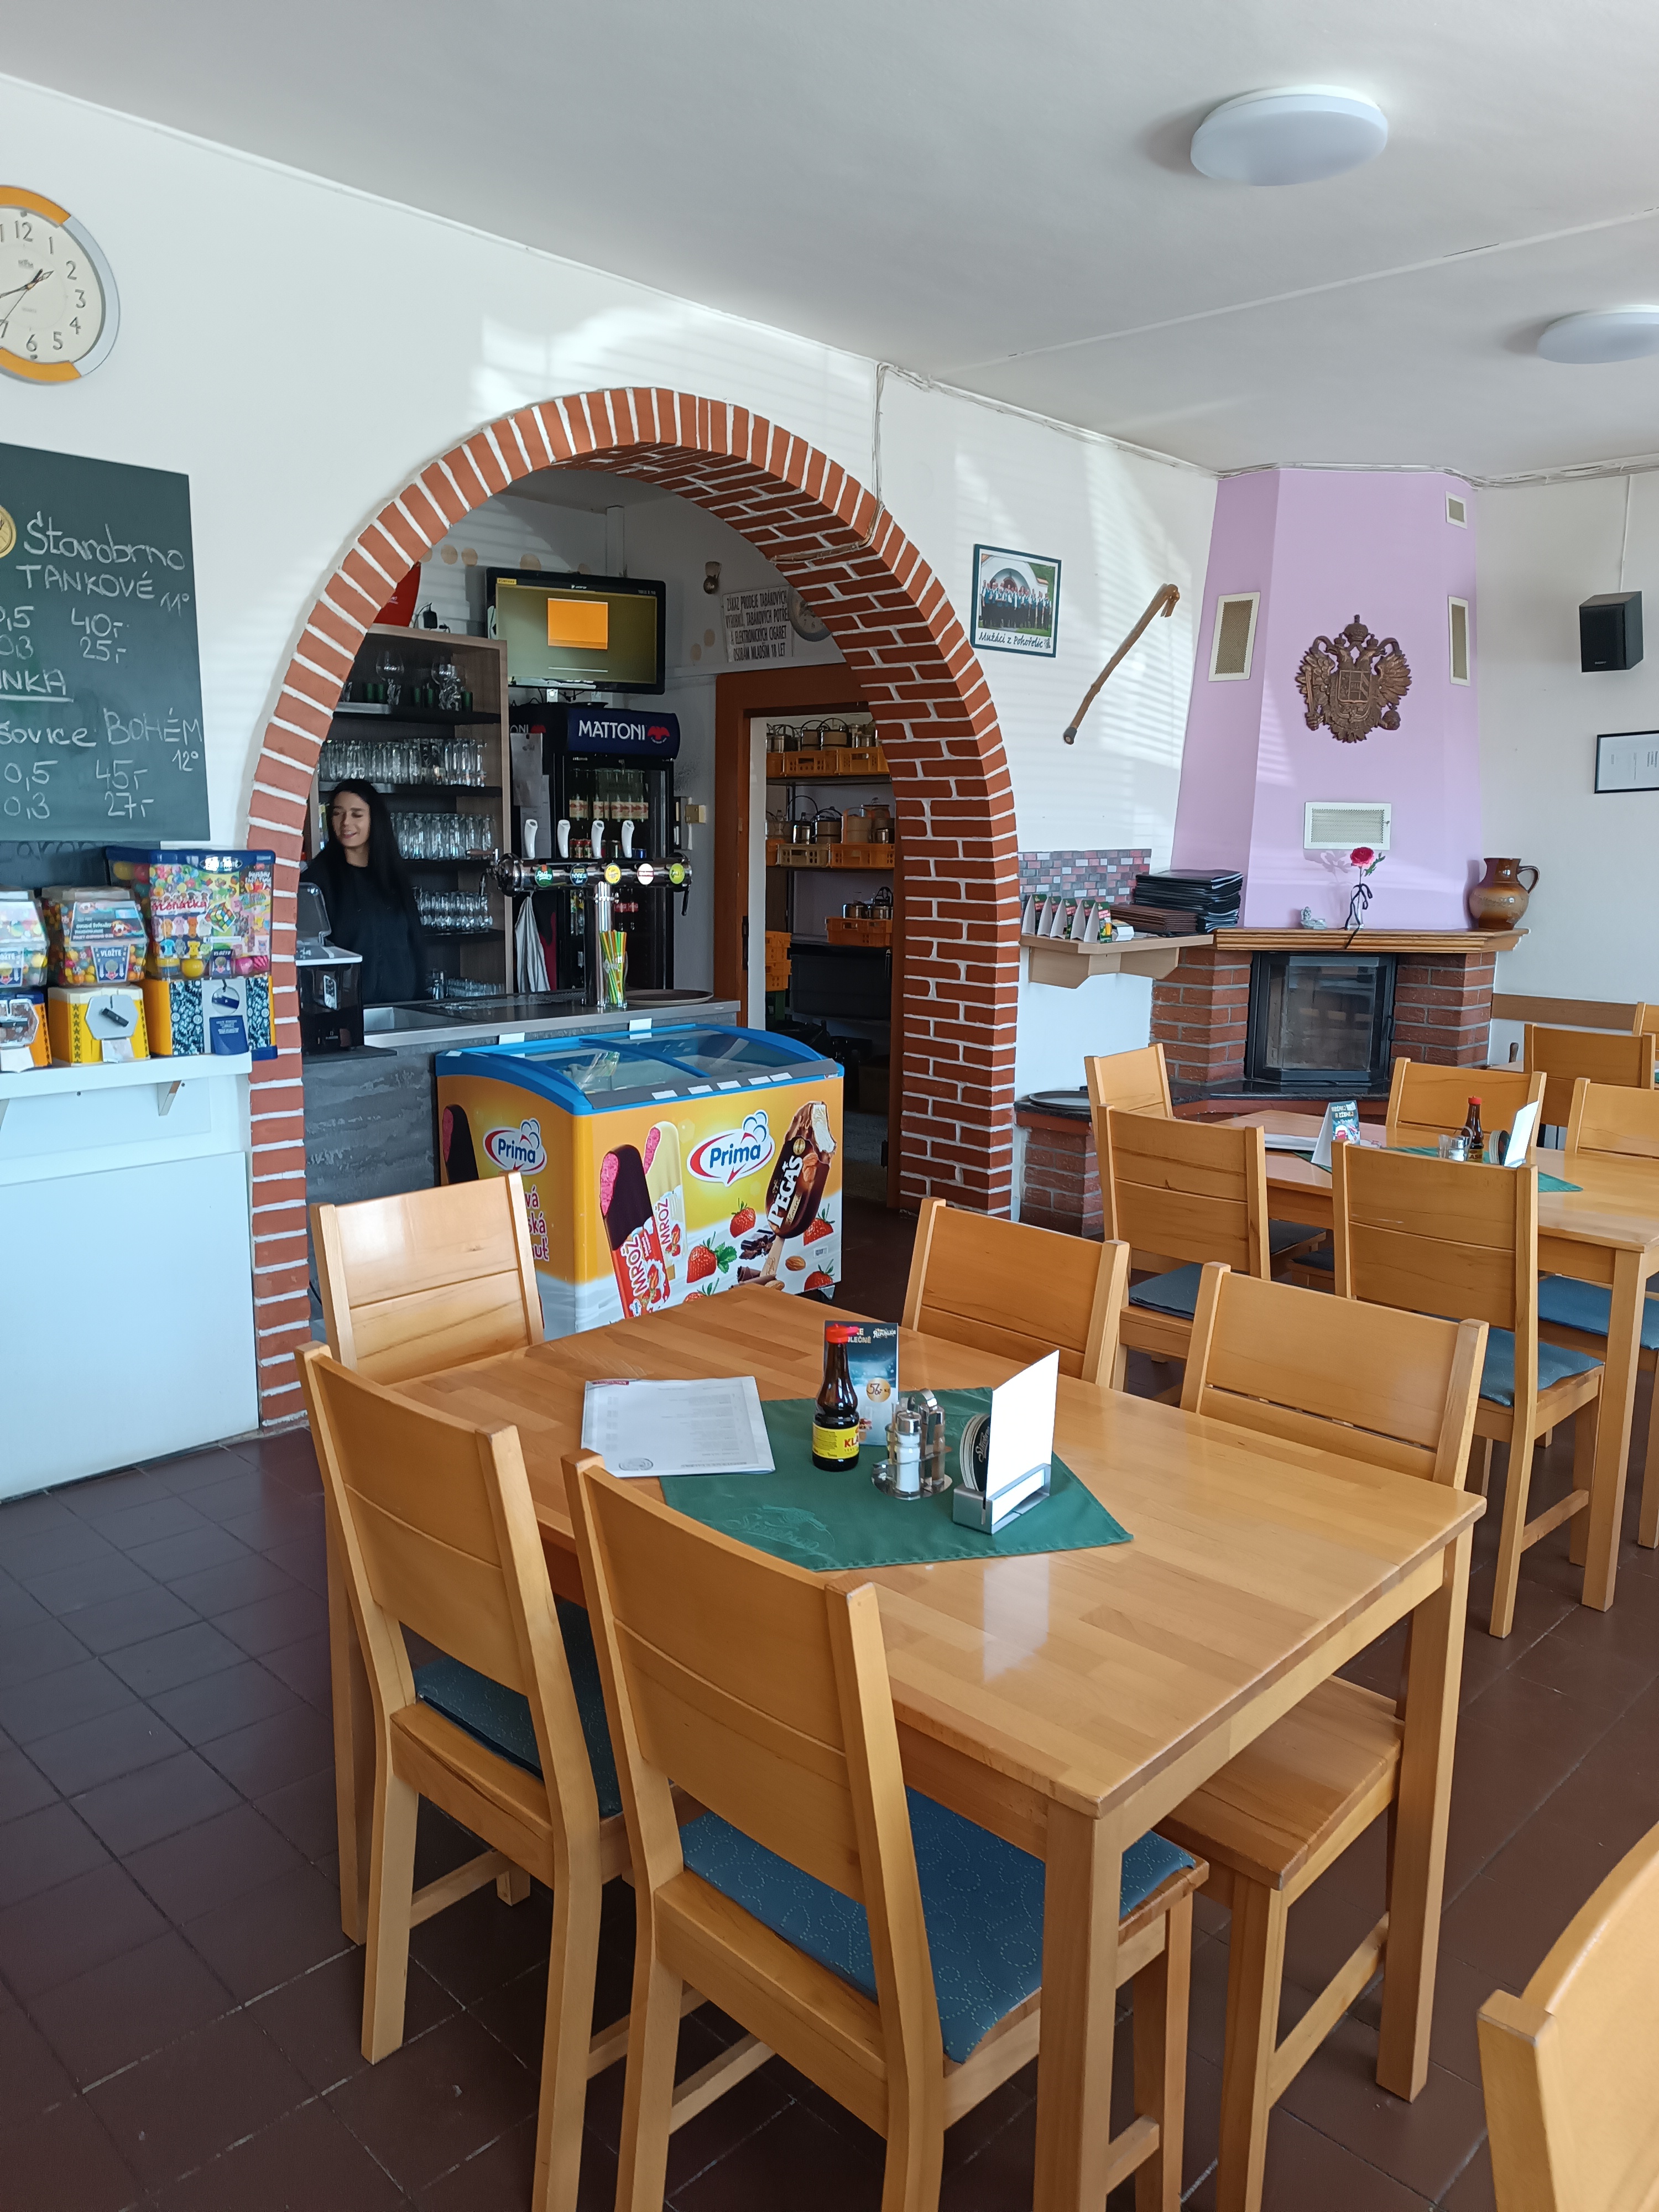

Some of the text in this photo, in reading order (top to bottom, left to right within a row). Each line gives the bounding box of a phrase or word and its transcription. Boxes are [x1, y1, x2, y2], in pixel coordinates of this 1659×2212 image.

[14, 220, 33, 242] 12
[49, 237, 54, 254] 1
[65, 260, 77, 280] 2
[75, 289, 86, 309] 3
[70, 317, 81, 335] 4
[26, 334, 38, 352] 6
[53, 332, 64, 351] 5
[24, 511, 185, 570] Starobrno
[15, 564, 155, 599] TANKOVÉ
[727, 587, 787, 612] ZÁKAZ PRODEJE TABÁKOVÝCH
[746, 608, 772, 627] TABÁKOVÝCH
[774, 606, 789, 622] POTŘE
[731, 625, 787, 645] A ELEKTRONICKÝCH CIGARET
[733, 644, 750, 661] OSOBÁM
[751, 642, 770, 659] MLADŠÍM
[771, 645, 777, 657] 18
[0, 668, 66, 696] NKA
[103, 707, 202, 746] BOHÉM
[578, 719, 646, 741] MATTONI
[4, 759, 59, 792] 0,5
[4, 791, 51, 820] 0,3
[100, 948, 122, 957] VLOŽTE
[498, 1138, 536, 1164] Prima
[709, 1142, 761, 1168] Prima
[525, 1186, 539, 1207] vá
[528, 1213, 546, 1234] ská
[655, 1198, 670, 1245] MROŽ
[620, 1234, 649, 1297] MROŽ
